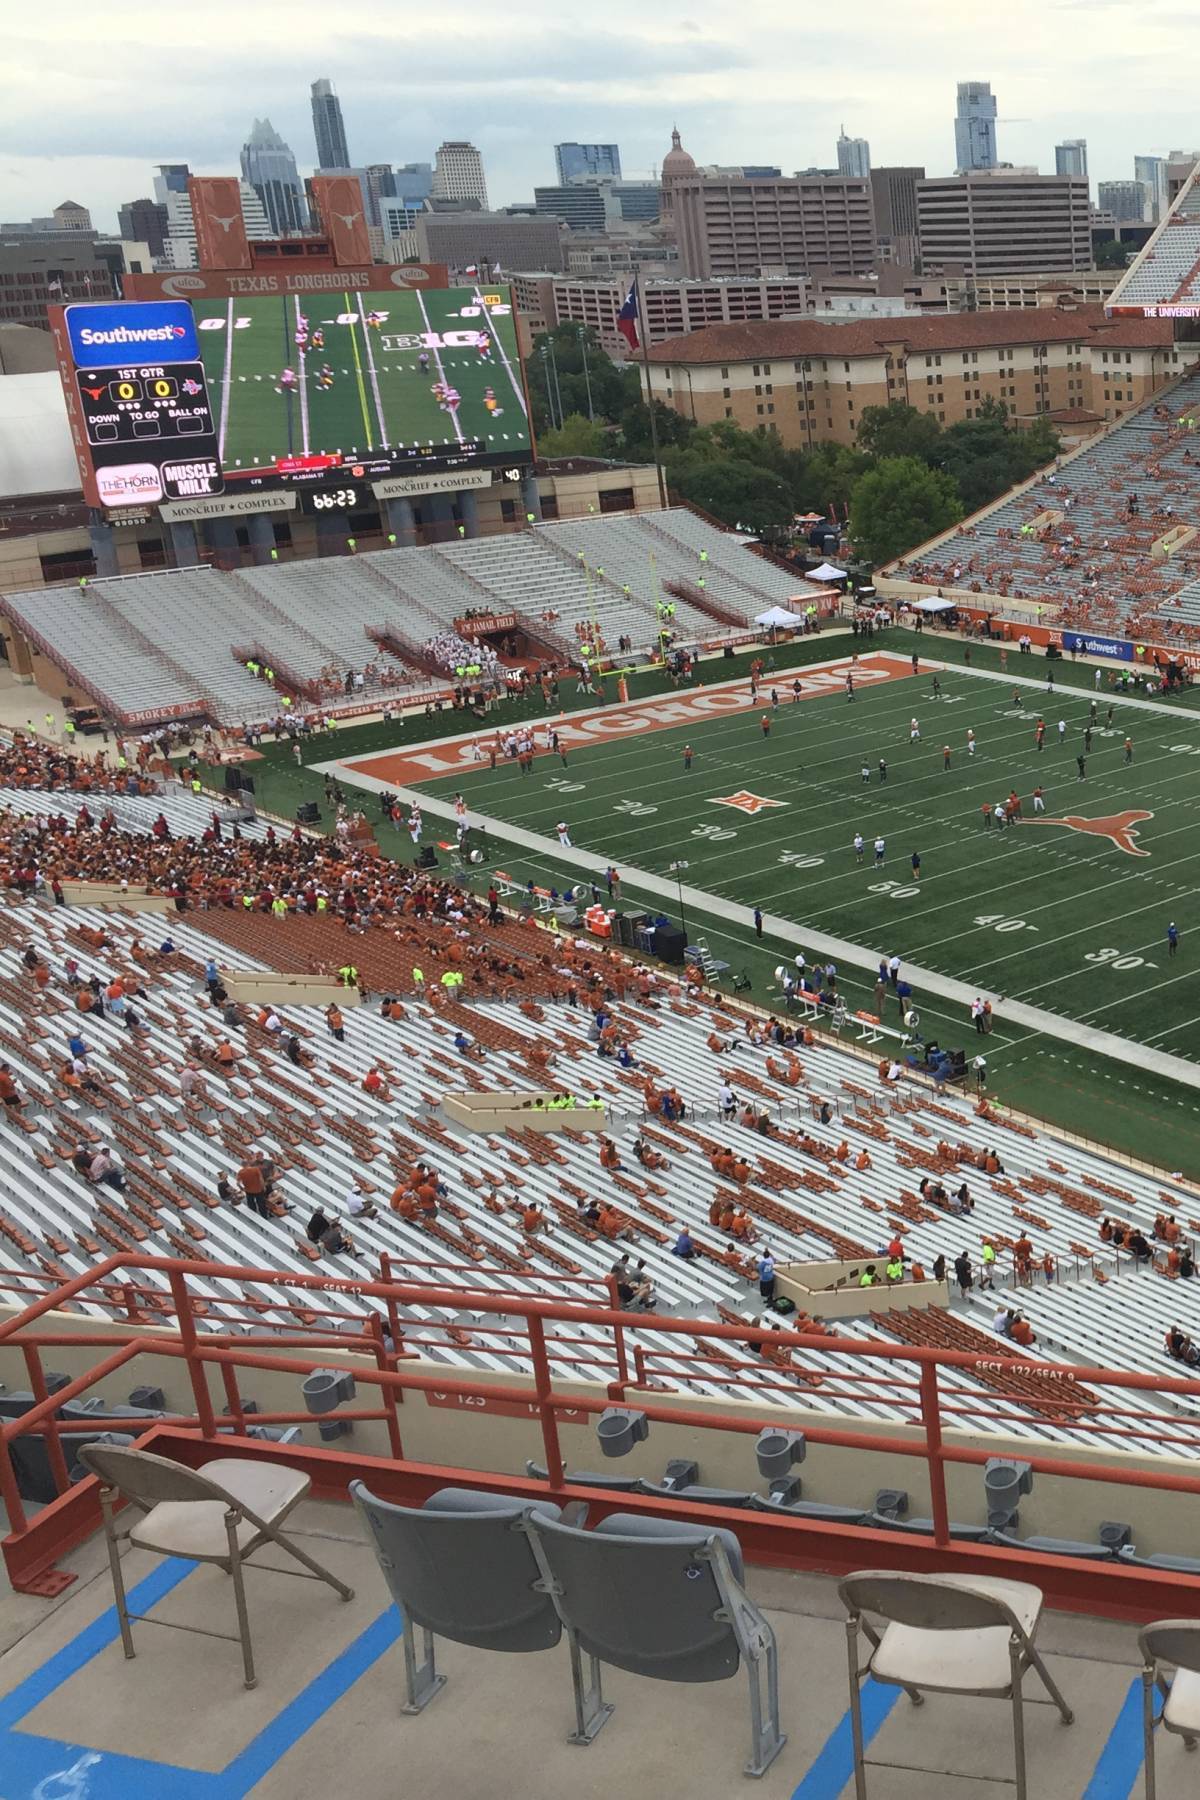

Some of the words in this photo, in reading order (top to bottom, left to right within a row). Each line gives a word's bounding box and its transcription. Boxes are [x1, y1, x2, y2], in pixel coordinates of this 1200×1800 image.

[226, 276, 278, 292] TEXAS
[286, 272, 369, 290] LONGHORNS
[1143, 307, 1157, 317] THE
[1159, 307, 1200, 317] UNIVERSITY
[80, 325, 174, 345] Southwest
[118, 368, 137, 379] 1ST
[140, 367, 165, 378] QTR
[119, 383, 134, 400] 0
[155, 380, 170, 397] 0
[89, 414, 120, 424] DOWN
[129, 412, 143, 421] TO
[144, 411, 159, 420] GO
[168, 408, 190, 418] BALL
[191, 407, 208, 416] ON
[164, 462, 219, 482] MUSCLE
[505, 468, 520, 481] 40
[177, 478, 212, 496] MILK
[383, 482, 431, 494] MONCRIEF
[439, 476, 484, 488] COMPLEX
[172, 504, 226, 517] MONCRIEF
[237, 498, 286, 510] COMPLEX
[313, 489, 357, 509] 66:23
[473, 620, 496, 632] JAMAIL
[496, 617, 514, 627] FIELD
[1075, 637, 1118, 655] Suthwest
[128, 706, 175, 722] SMOKEY
[544, 779, 587, 794] 10
[612, 801, 659, 816] 20
[690, 824, 738, 841] 30
[776, 850, 825, 869] 40
[866, 880, 921, 899] 50
[972, 913, 1027, 933] 40
[1084, 947, 1145, 970] 30
[975, 1360, 1003, 1372] SECT
[1067, 1372, 1075, 1381] 9
